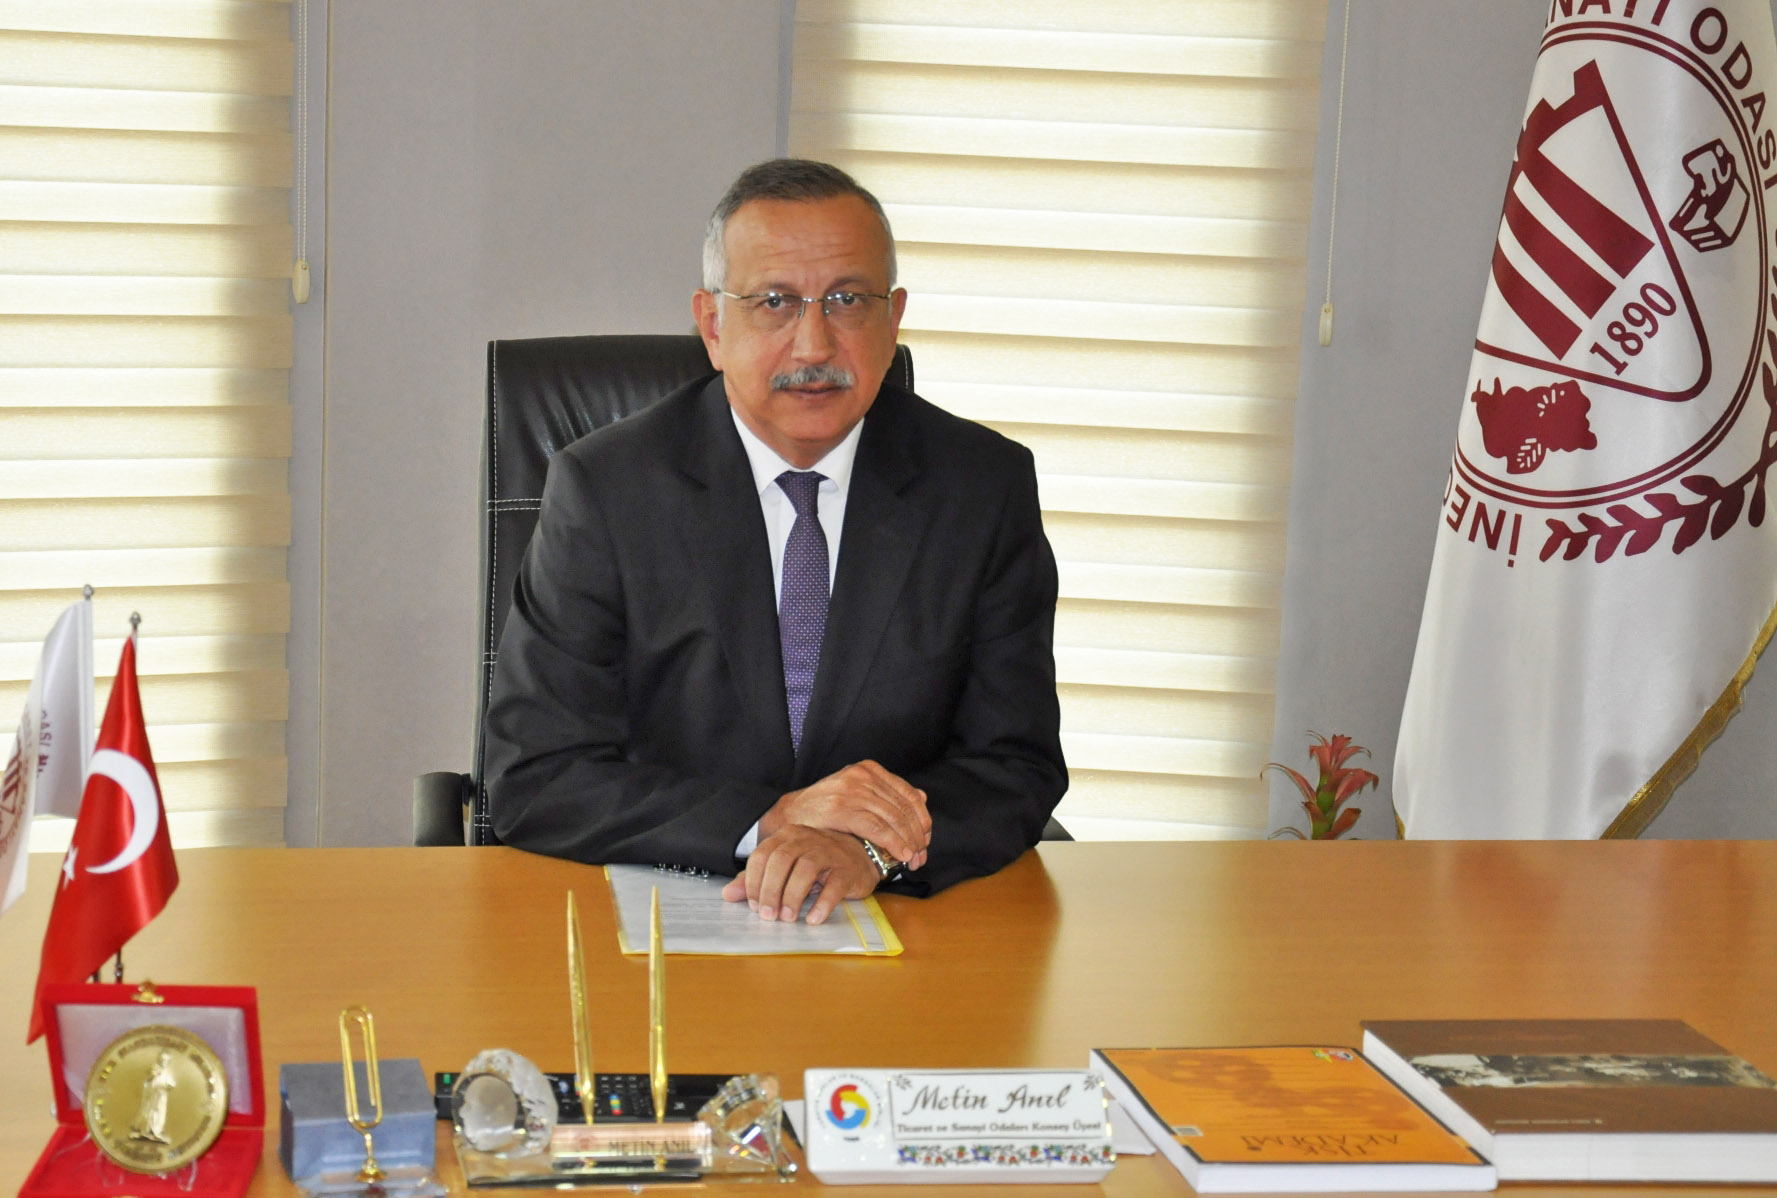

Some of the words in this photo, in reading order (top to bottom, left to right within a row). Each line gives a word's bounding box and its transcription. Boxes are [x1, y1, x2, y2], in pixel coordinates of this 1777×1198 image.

[1589, 282, 1677, 376] 1890
[1444, 475, 1523, 568] İNE
[902, 1084, 988, 1115] Metin
